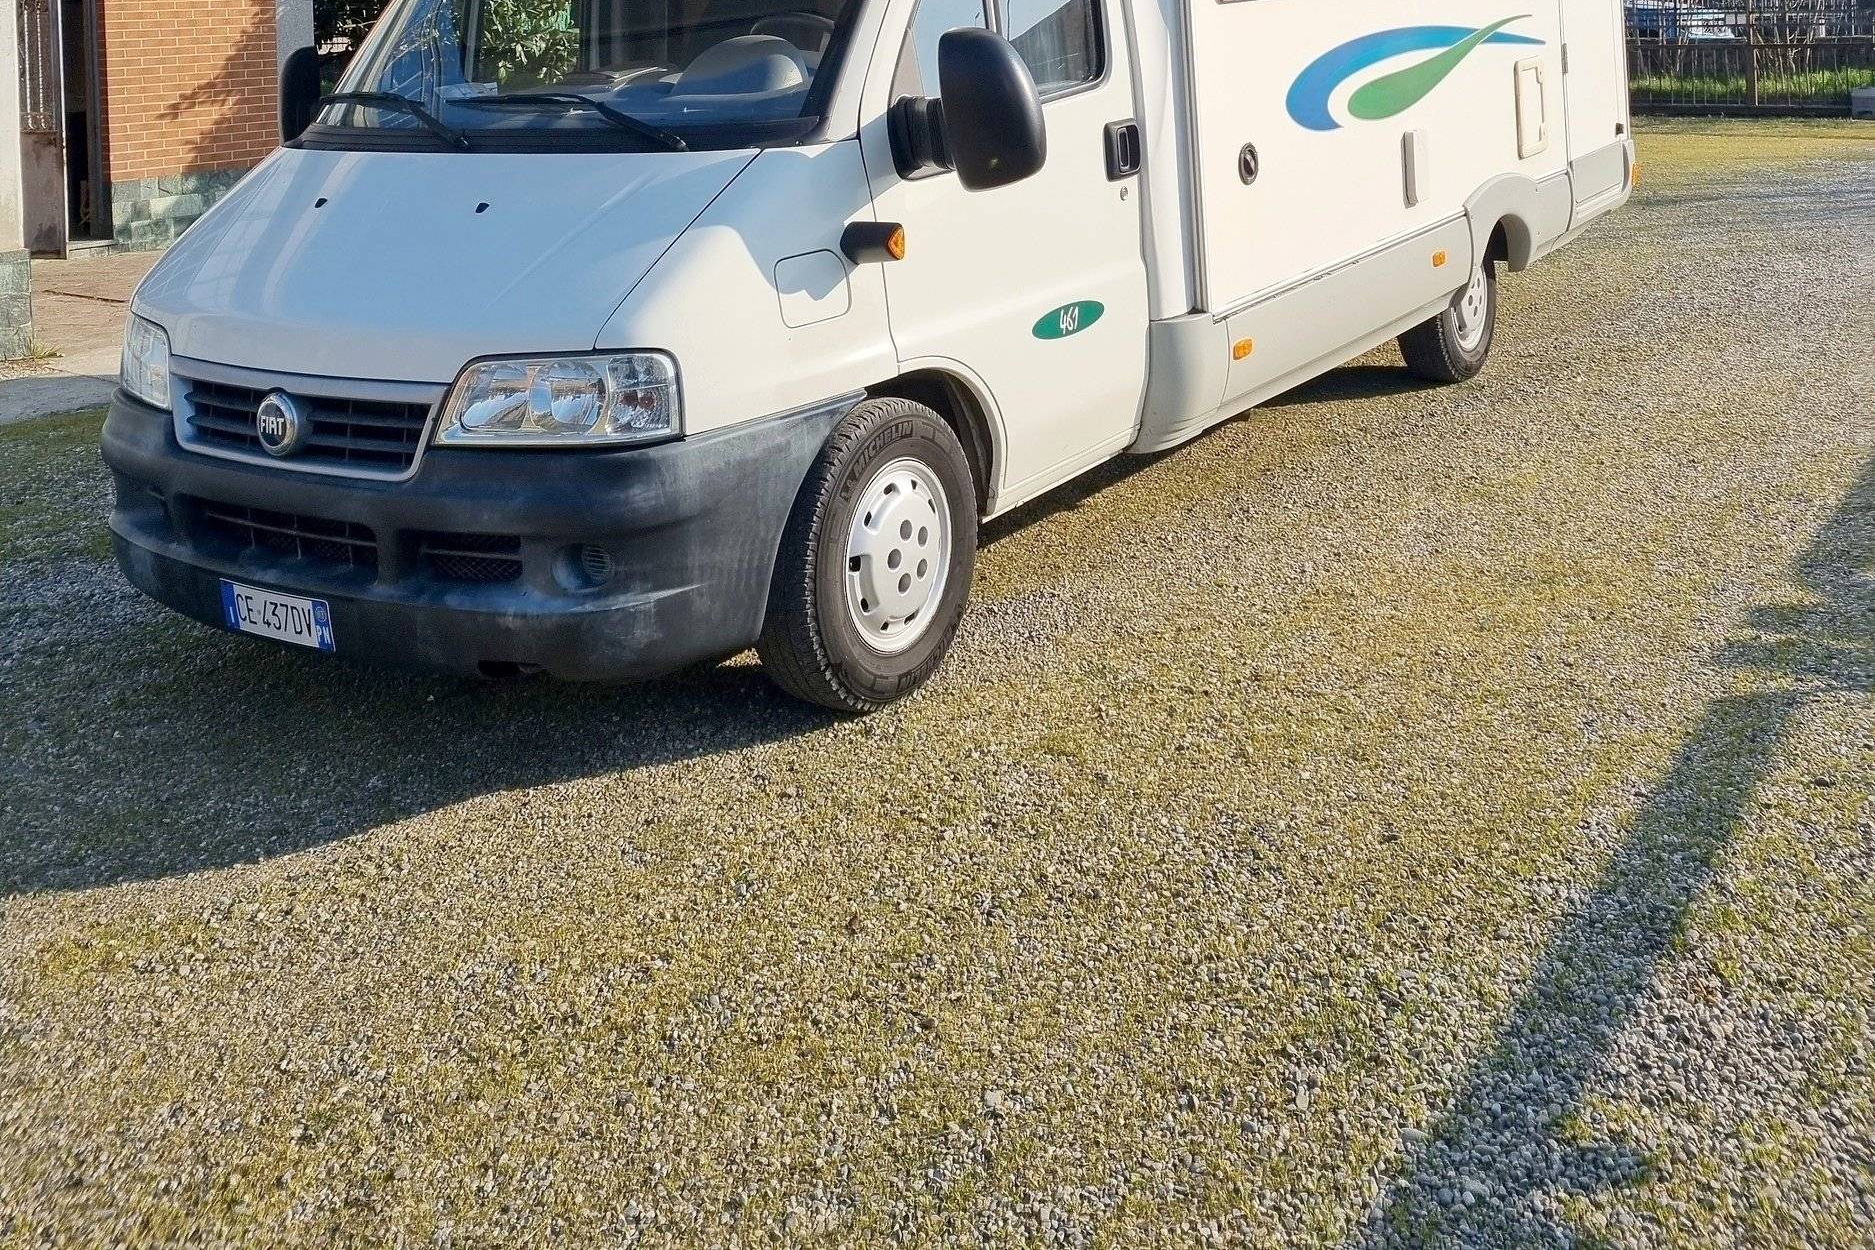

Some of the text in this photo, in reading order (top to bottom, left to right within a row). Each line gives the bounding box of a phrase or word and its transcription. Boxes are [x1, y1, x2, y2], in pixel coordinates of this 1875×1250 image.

[1059, 306, 1079, 334] 461
[261, 415, 285, 435] FIAT
[235, 593, 257, 625] CE
[262, 600, 312, 637] 437DV
